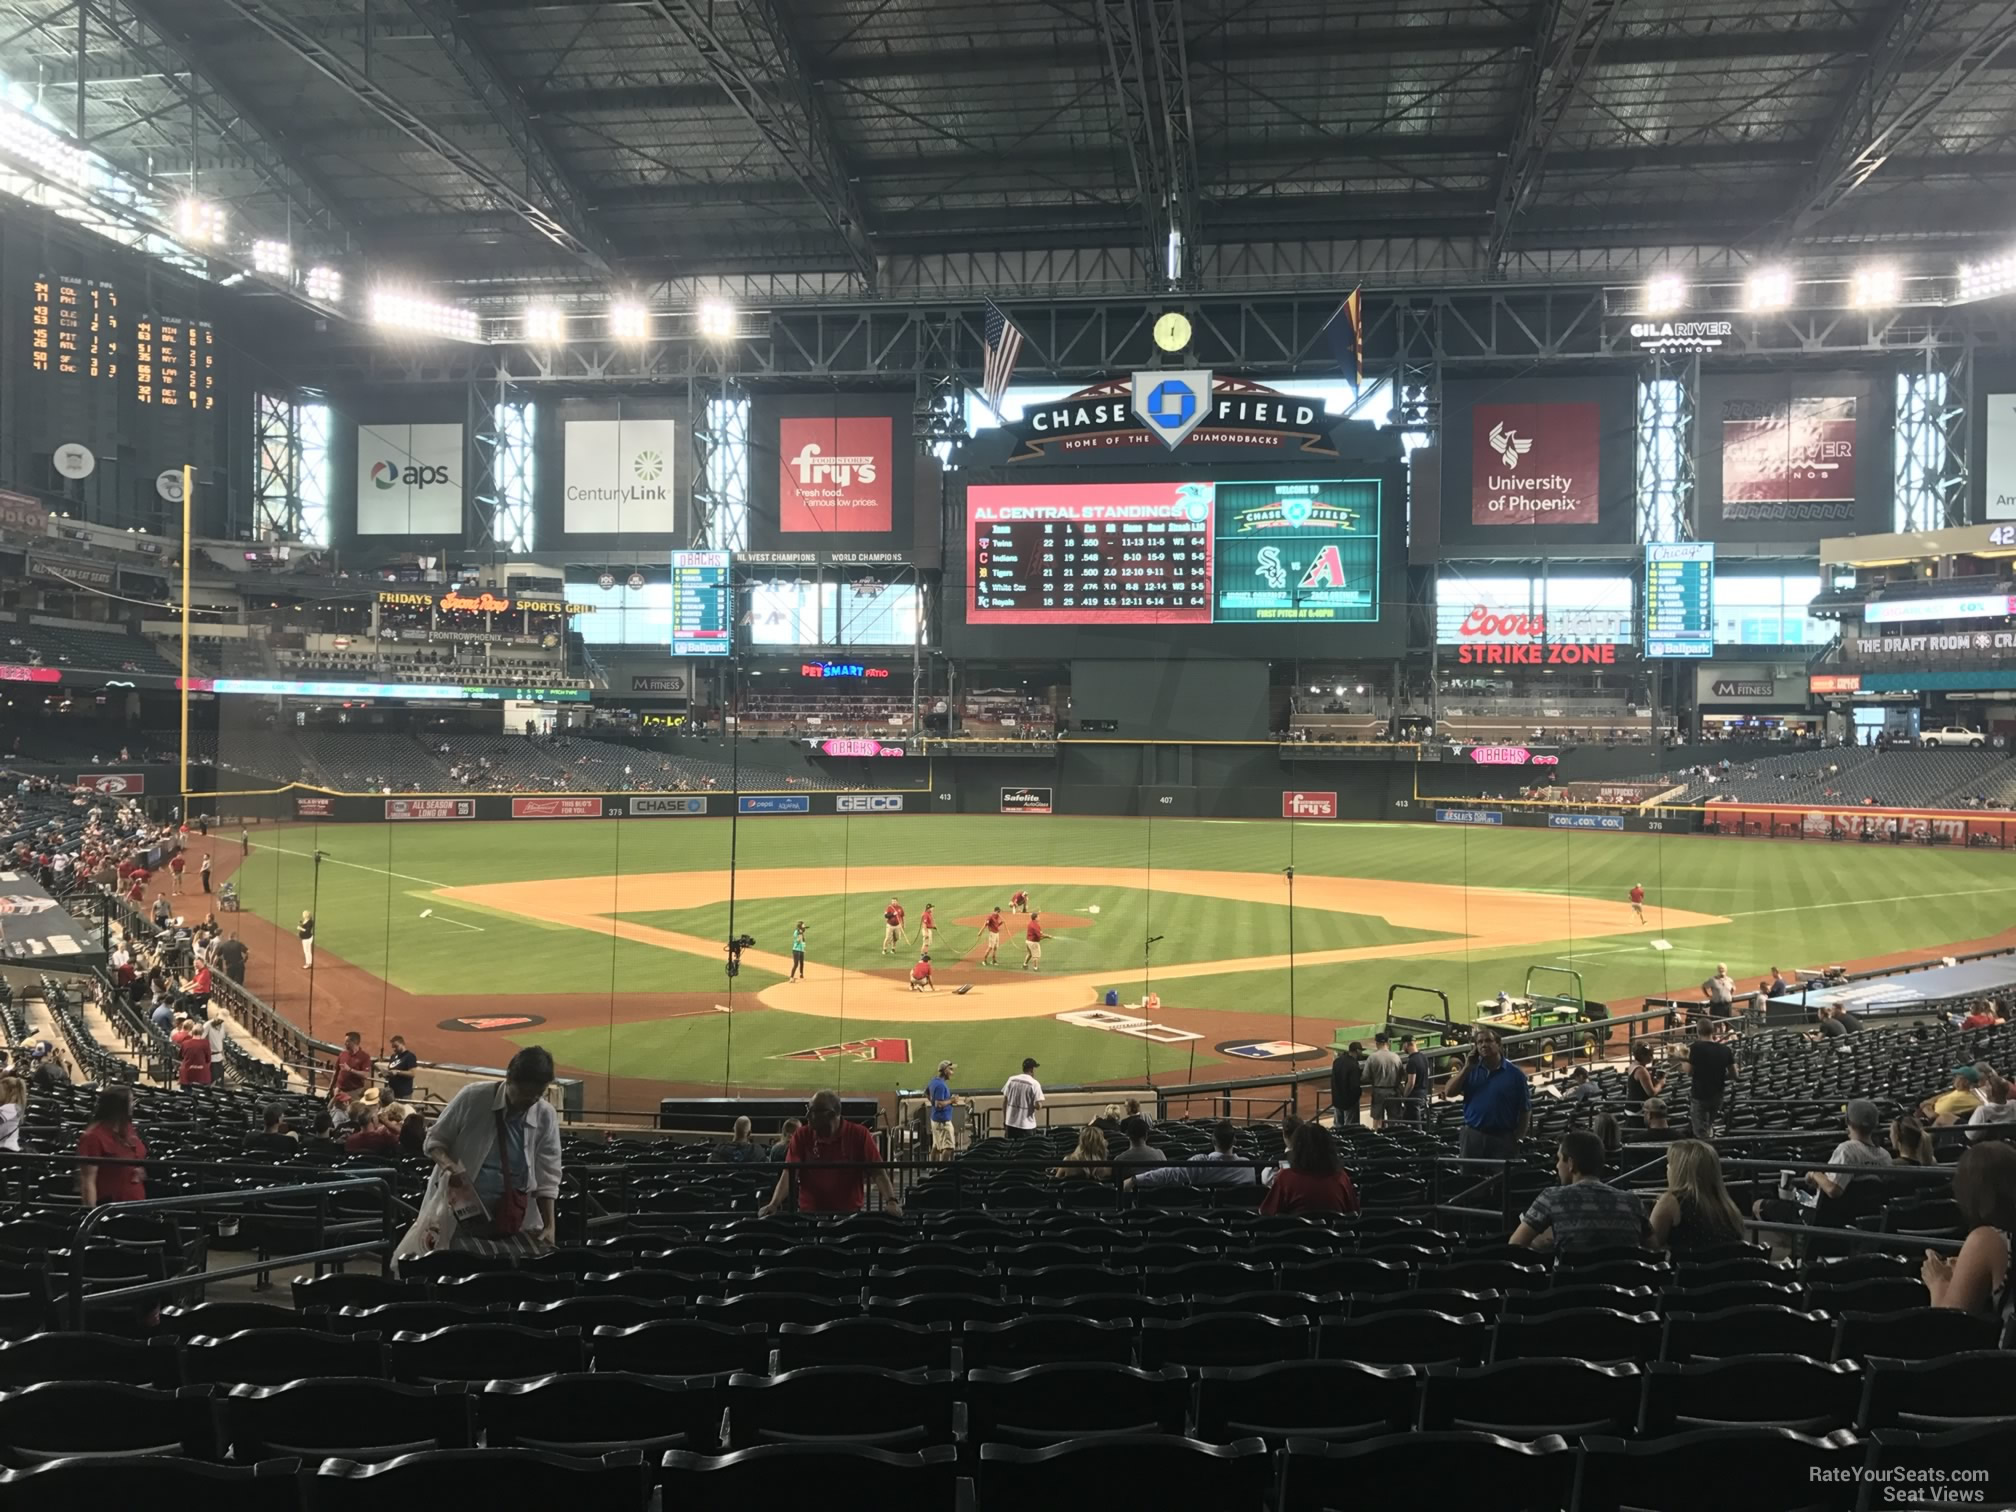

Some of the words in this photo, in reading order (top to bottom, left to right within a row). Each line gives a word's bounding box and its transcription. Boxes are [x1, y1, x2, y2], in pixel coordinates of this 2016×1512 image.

[60, 310, 77, 318] CLE
[60, 319, 77, 327] CIN
[60, 332, 76, 340] PIT
[1649, 346, 1712, 354] CASINOS
[1032, 404, 1125, 431] CHASE
[1219, 402, 1314, 425] FIELD
[1065, 438, 1097, 449] HOME
[1105, 436, 1120, 444] OF
[1129, 435, 1150, 443] THE
[1193, 434, 1279, 445] DIAMONDBACKS
[791, 443, 876, 487] fry's
[402, 464, 449, 489] aps
[1488, 474, 1572, 493] University
[567, 485, 667, 503] CenturyLink
[796, 489, 820, 497] Fresh
[822, 489, 844, 497] food.
[1275, 486, 1308, 494] WELCOME
[803, 498, 836, 507] Famous
[852, 499, 878, 508] prices.
[1488, 496, 1506, 511] of
[1509, 496, 1575, 511] Phoenix
[975, 507, 997, 519] AL
[999, 507, 1080, 519] CENTRAL
[1082, 506, 1183, 518] STANDINGS
[1246, 512, 1281, 521] CHASE
[1312, 510, 1348, 520] FIELD
[1989, 526, 2014, 544] 42
[992, 540, 1013, 548] Twins
[1043, 539, 1054, 547] 22
[1064, 539, 1075, 547] 18
[1122, 538, 1144, 546] 11-13
[1173, 538, 1184, 546] W1
[772, 553, 816, 561] CHAMPIONS
[832, 553, 857, 561] WORLD
[859, 553, 902, 561] CHAMPIONS
[993, 554, 1018, 562] Indians
[1043, 554, 1053, 562] 23
[1064, 554, 1074, 562] 19
[90, 572, 110, 583] SEATS
[992, 569, 1013, 578] Tigers
[1104, 568, 1117, 576] 2.0
[1122, 568, 1144, 576] 12-10
[1146, 568, 1164, 576] 9-11
[1043, 583, 1053, 591] 20
[1063, 583, 1074, 591] 22
[1145, 583, 1167, 591] 12-14
[379, 592, 432, 605] FRIDAY'S
[516, 600, 561, 612] SPORTS
[565, 603, 596, 614] GRILL
[992, 598, 1015, 607] Royals
[1043, 598, 1053, 606] 18
[1063, 598, 1074, 606] 25
[1081, 598, 1098, 606] .419
[1121, 598, 1142, 606] 12-11
[1173, 597, 1183, 605] L1
[1459, 604, 1545, 636] Coors
[1547, 614, 1628, 636] LIGHT
[429, 631, 514, 642] FRONTROWPHOENIX.com
[687, 643, 726, 654] Ballpark
[1664, 643, 1709, 655] Ballpark
[1857, 639, 1881, 653] THE
[1884, 637, 1926, 652] DRAFT
[1930, 635, 1970, 650] ROOM
[1458, 644, 1543, 664] STRIKE
[1547, 644, 1615, 664] ZONE
[865, 669, 889, 677] PATIO
[634, 680, 648, 689] M
[650, 681, 680, 690] FITNESS
[1718, 683, 1735, 695] M
[1737, 686, 1772, 695] FITNESS
[1614, 788, 1633, 796] TRUCKS
[412, 801, 424, 809] ALL
[426, 801, 453, 809] SEASON
[637, 800, 685, 811] CHASE
[838, 796, 901, 811] GEICO
[1289, 794, 1331, 815] fry's
[419, 809, 436, 817] LONG
[437, 809, 447, 817] ON
[1555, 817, 1571, 825] COX
[1578, 818, 1595, 826] COX
[1602, 819, 1619, 827] COX
[1649, 821, 1662, 830] 376
[1901, 817, 1966, 839] Farm
